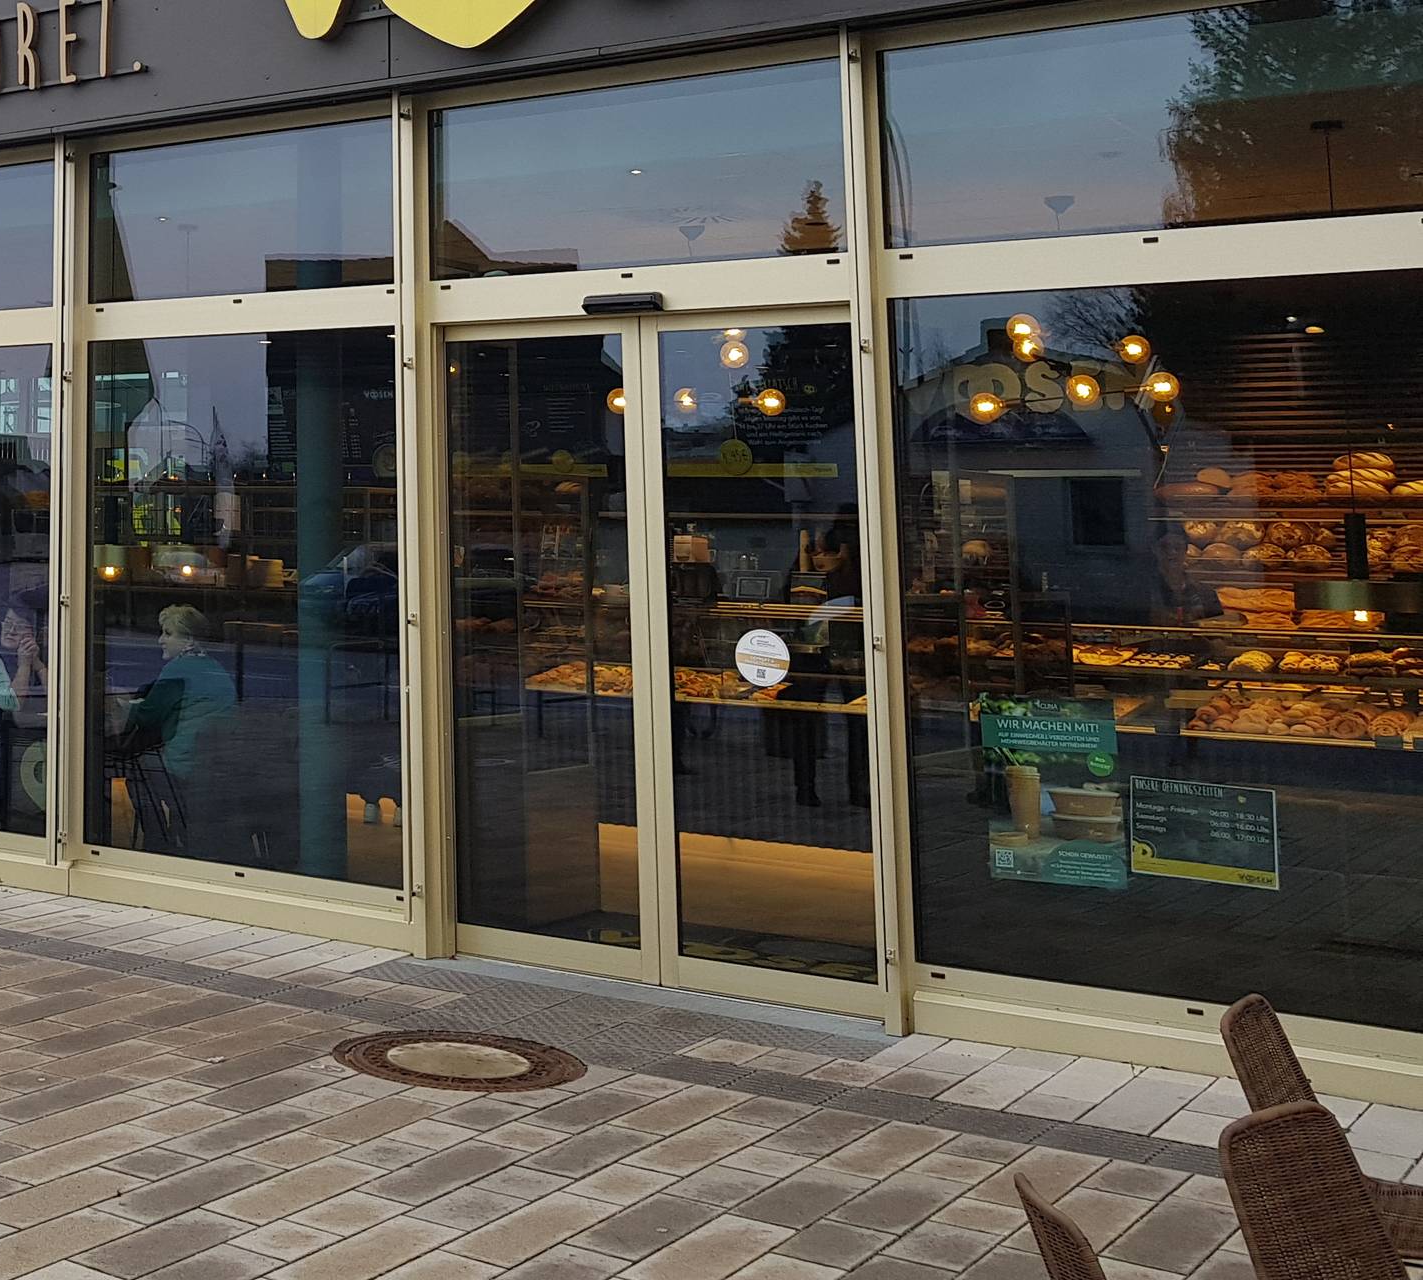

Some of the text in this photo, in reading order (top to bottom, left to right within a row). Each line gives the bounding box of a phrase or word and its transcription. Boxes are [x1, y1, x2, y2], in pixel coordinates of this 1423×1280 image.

[997, 719, 1100, 733] WIR MACHEN MIT!
